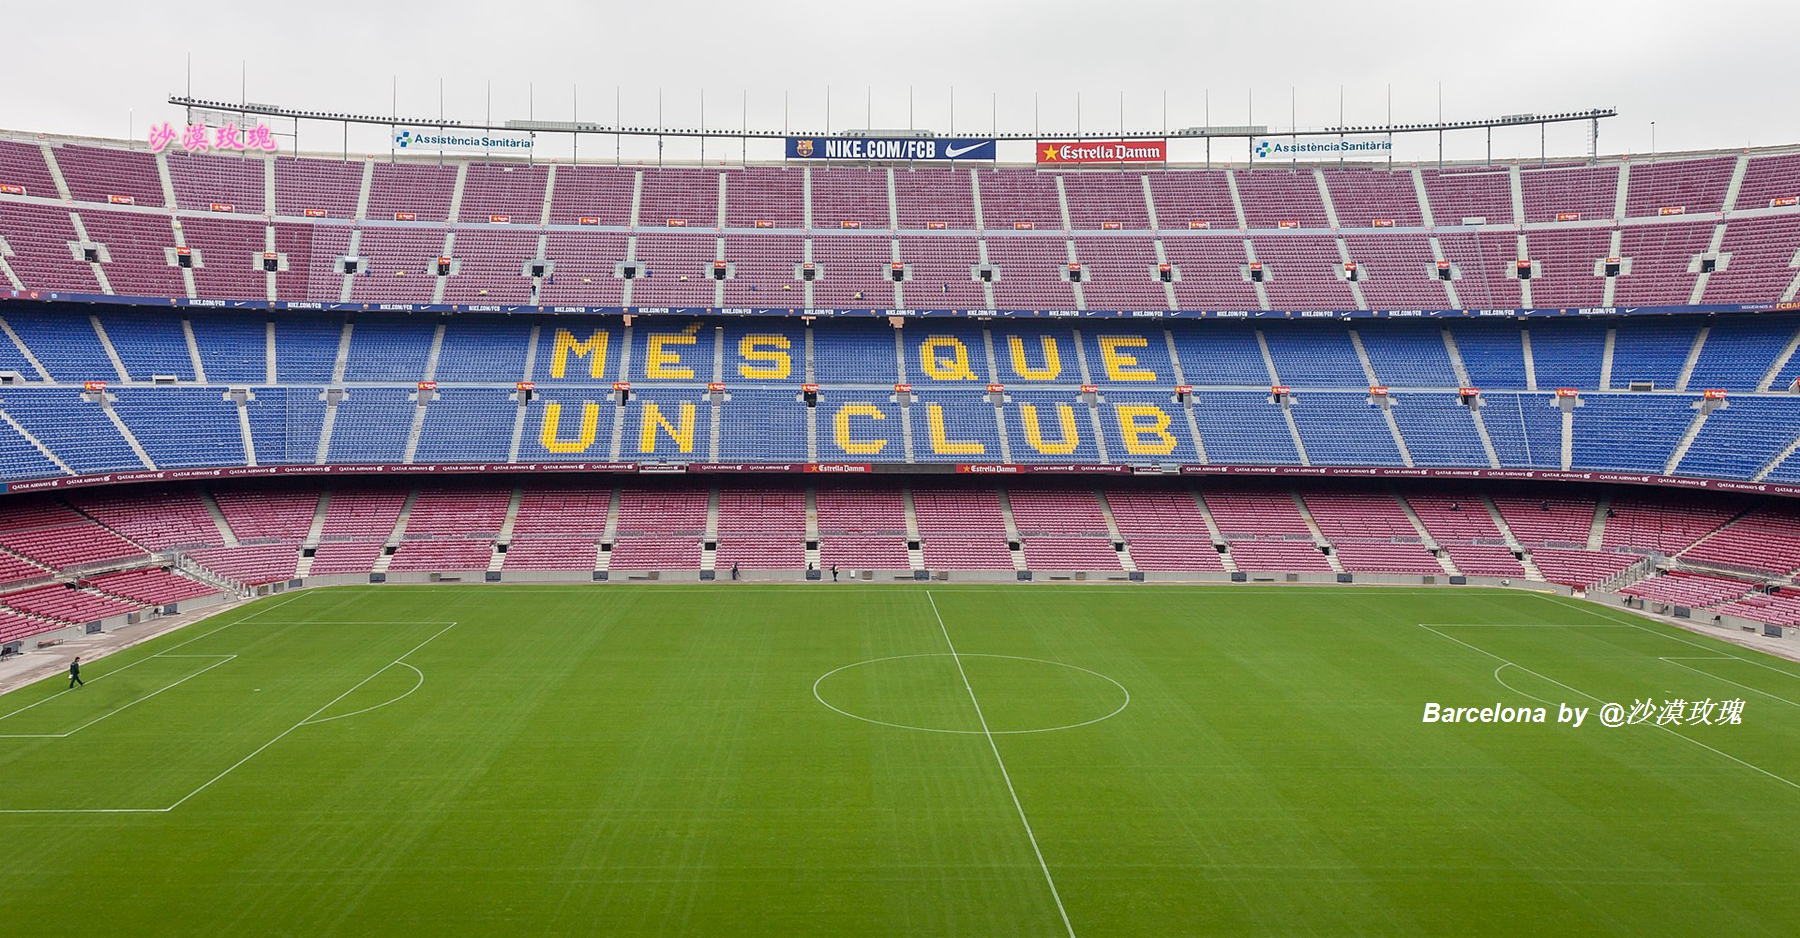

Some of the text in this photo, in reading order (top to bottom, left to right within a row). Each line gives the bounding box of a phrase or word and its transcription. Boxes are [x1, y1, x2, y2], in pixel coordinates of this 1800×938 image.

[414, 134, 531, 148] Assistència Sanitària
[825, 139, 936, 159] NIKE.COM/FCB
[1274, 140, 1392, 152] Assistència Sanitària
[1060, 145, 1161, 160] Estrella Damm
[550, 322, 1157, 381] MÉS QUE
[540, 401, 1178, 455] UN CLUB
